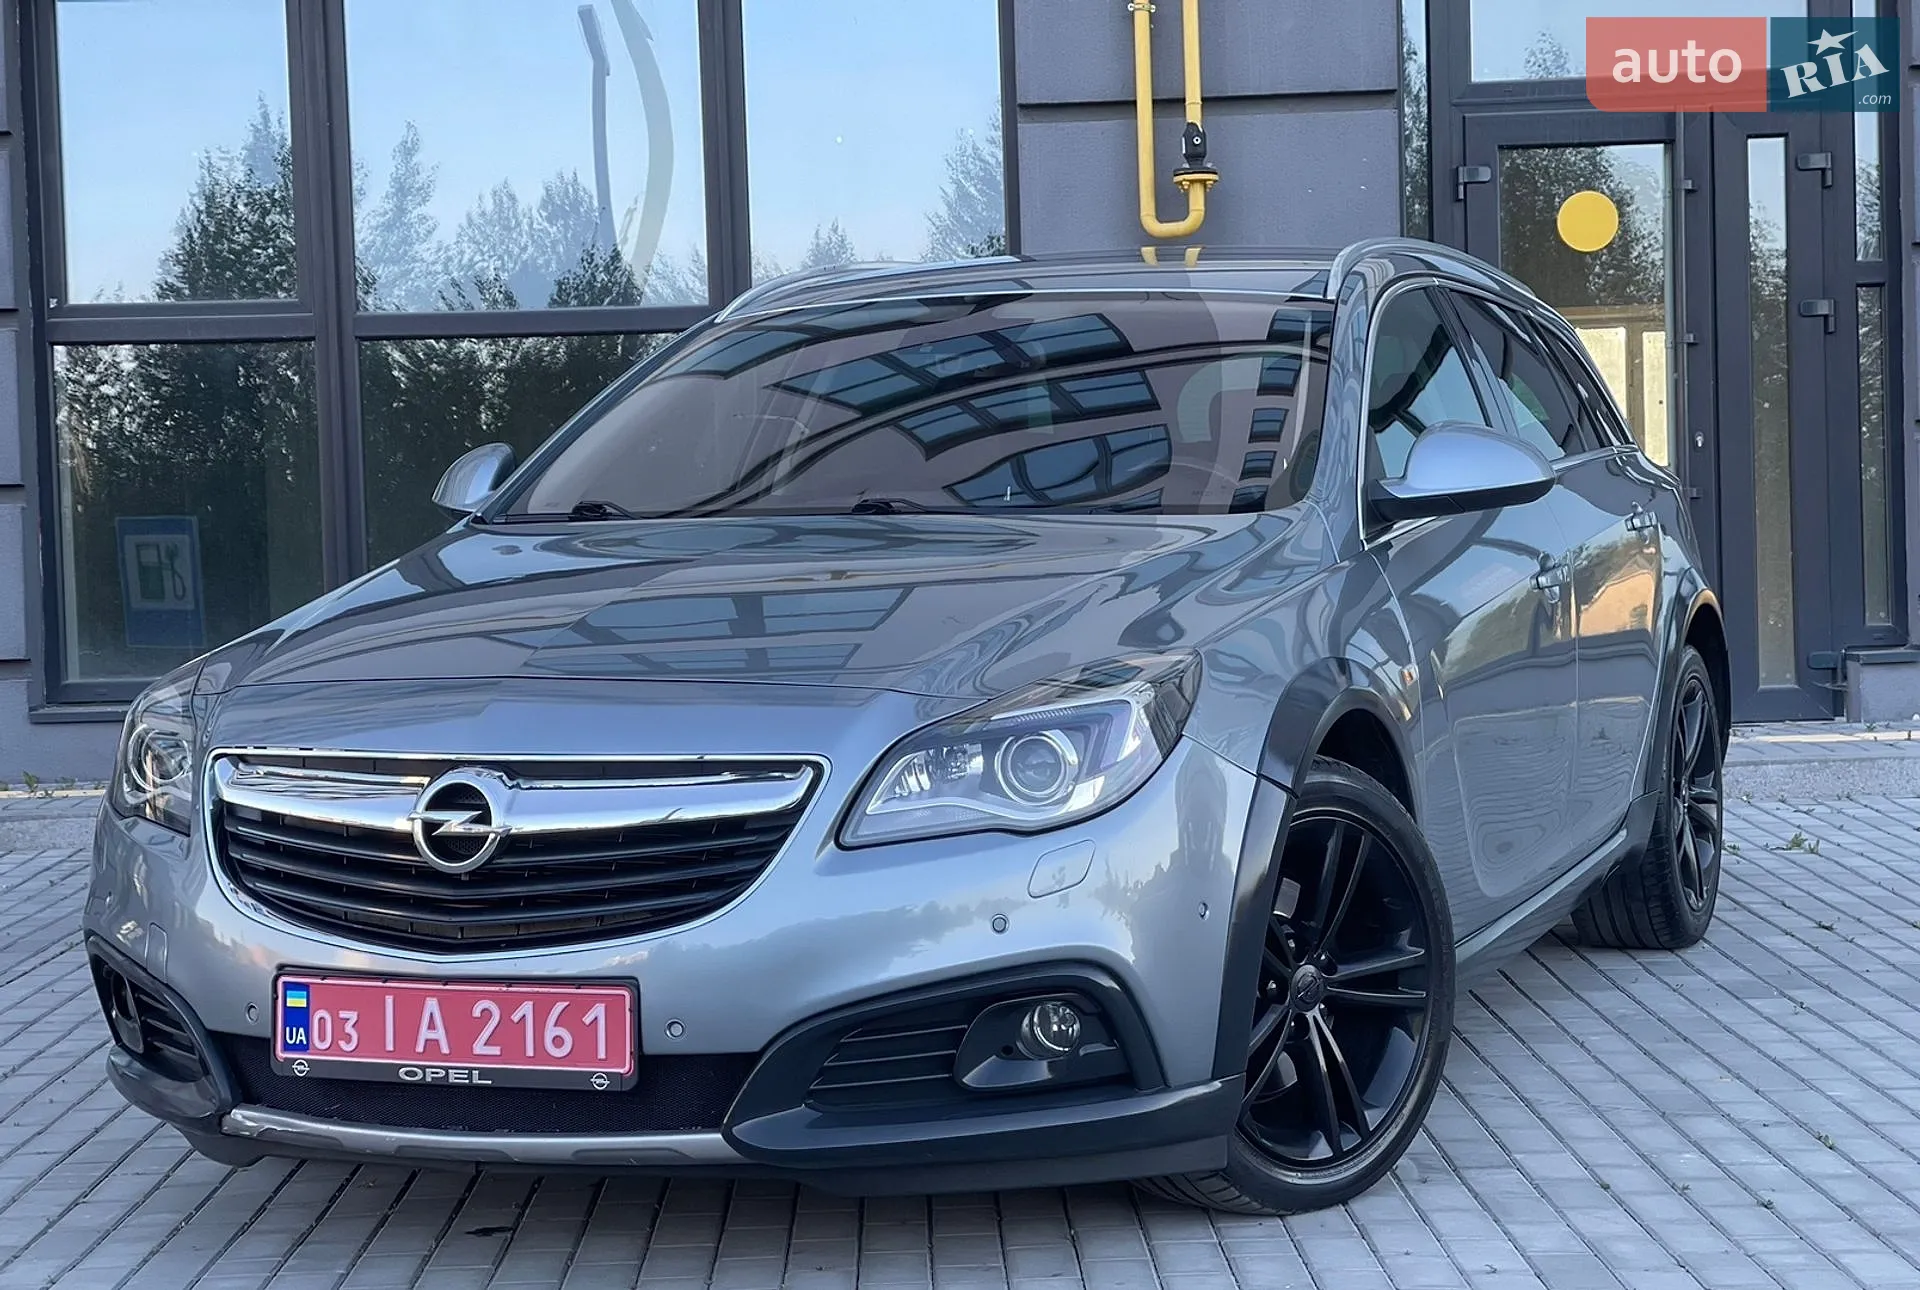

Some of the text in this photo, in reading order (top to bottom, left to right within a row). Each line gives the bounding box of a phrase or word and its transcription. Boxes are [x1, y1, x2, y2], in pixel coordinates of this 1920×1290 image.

[285, 1026, 307, 1046] UA
[312, 1008, 359, 1053] 03
[471, 998, 608, 1060] 2161
[398, 1066, 492, 1084] OPEL
